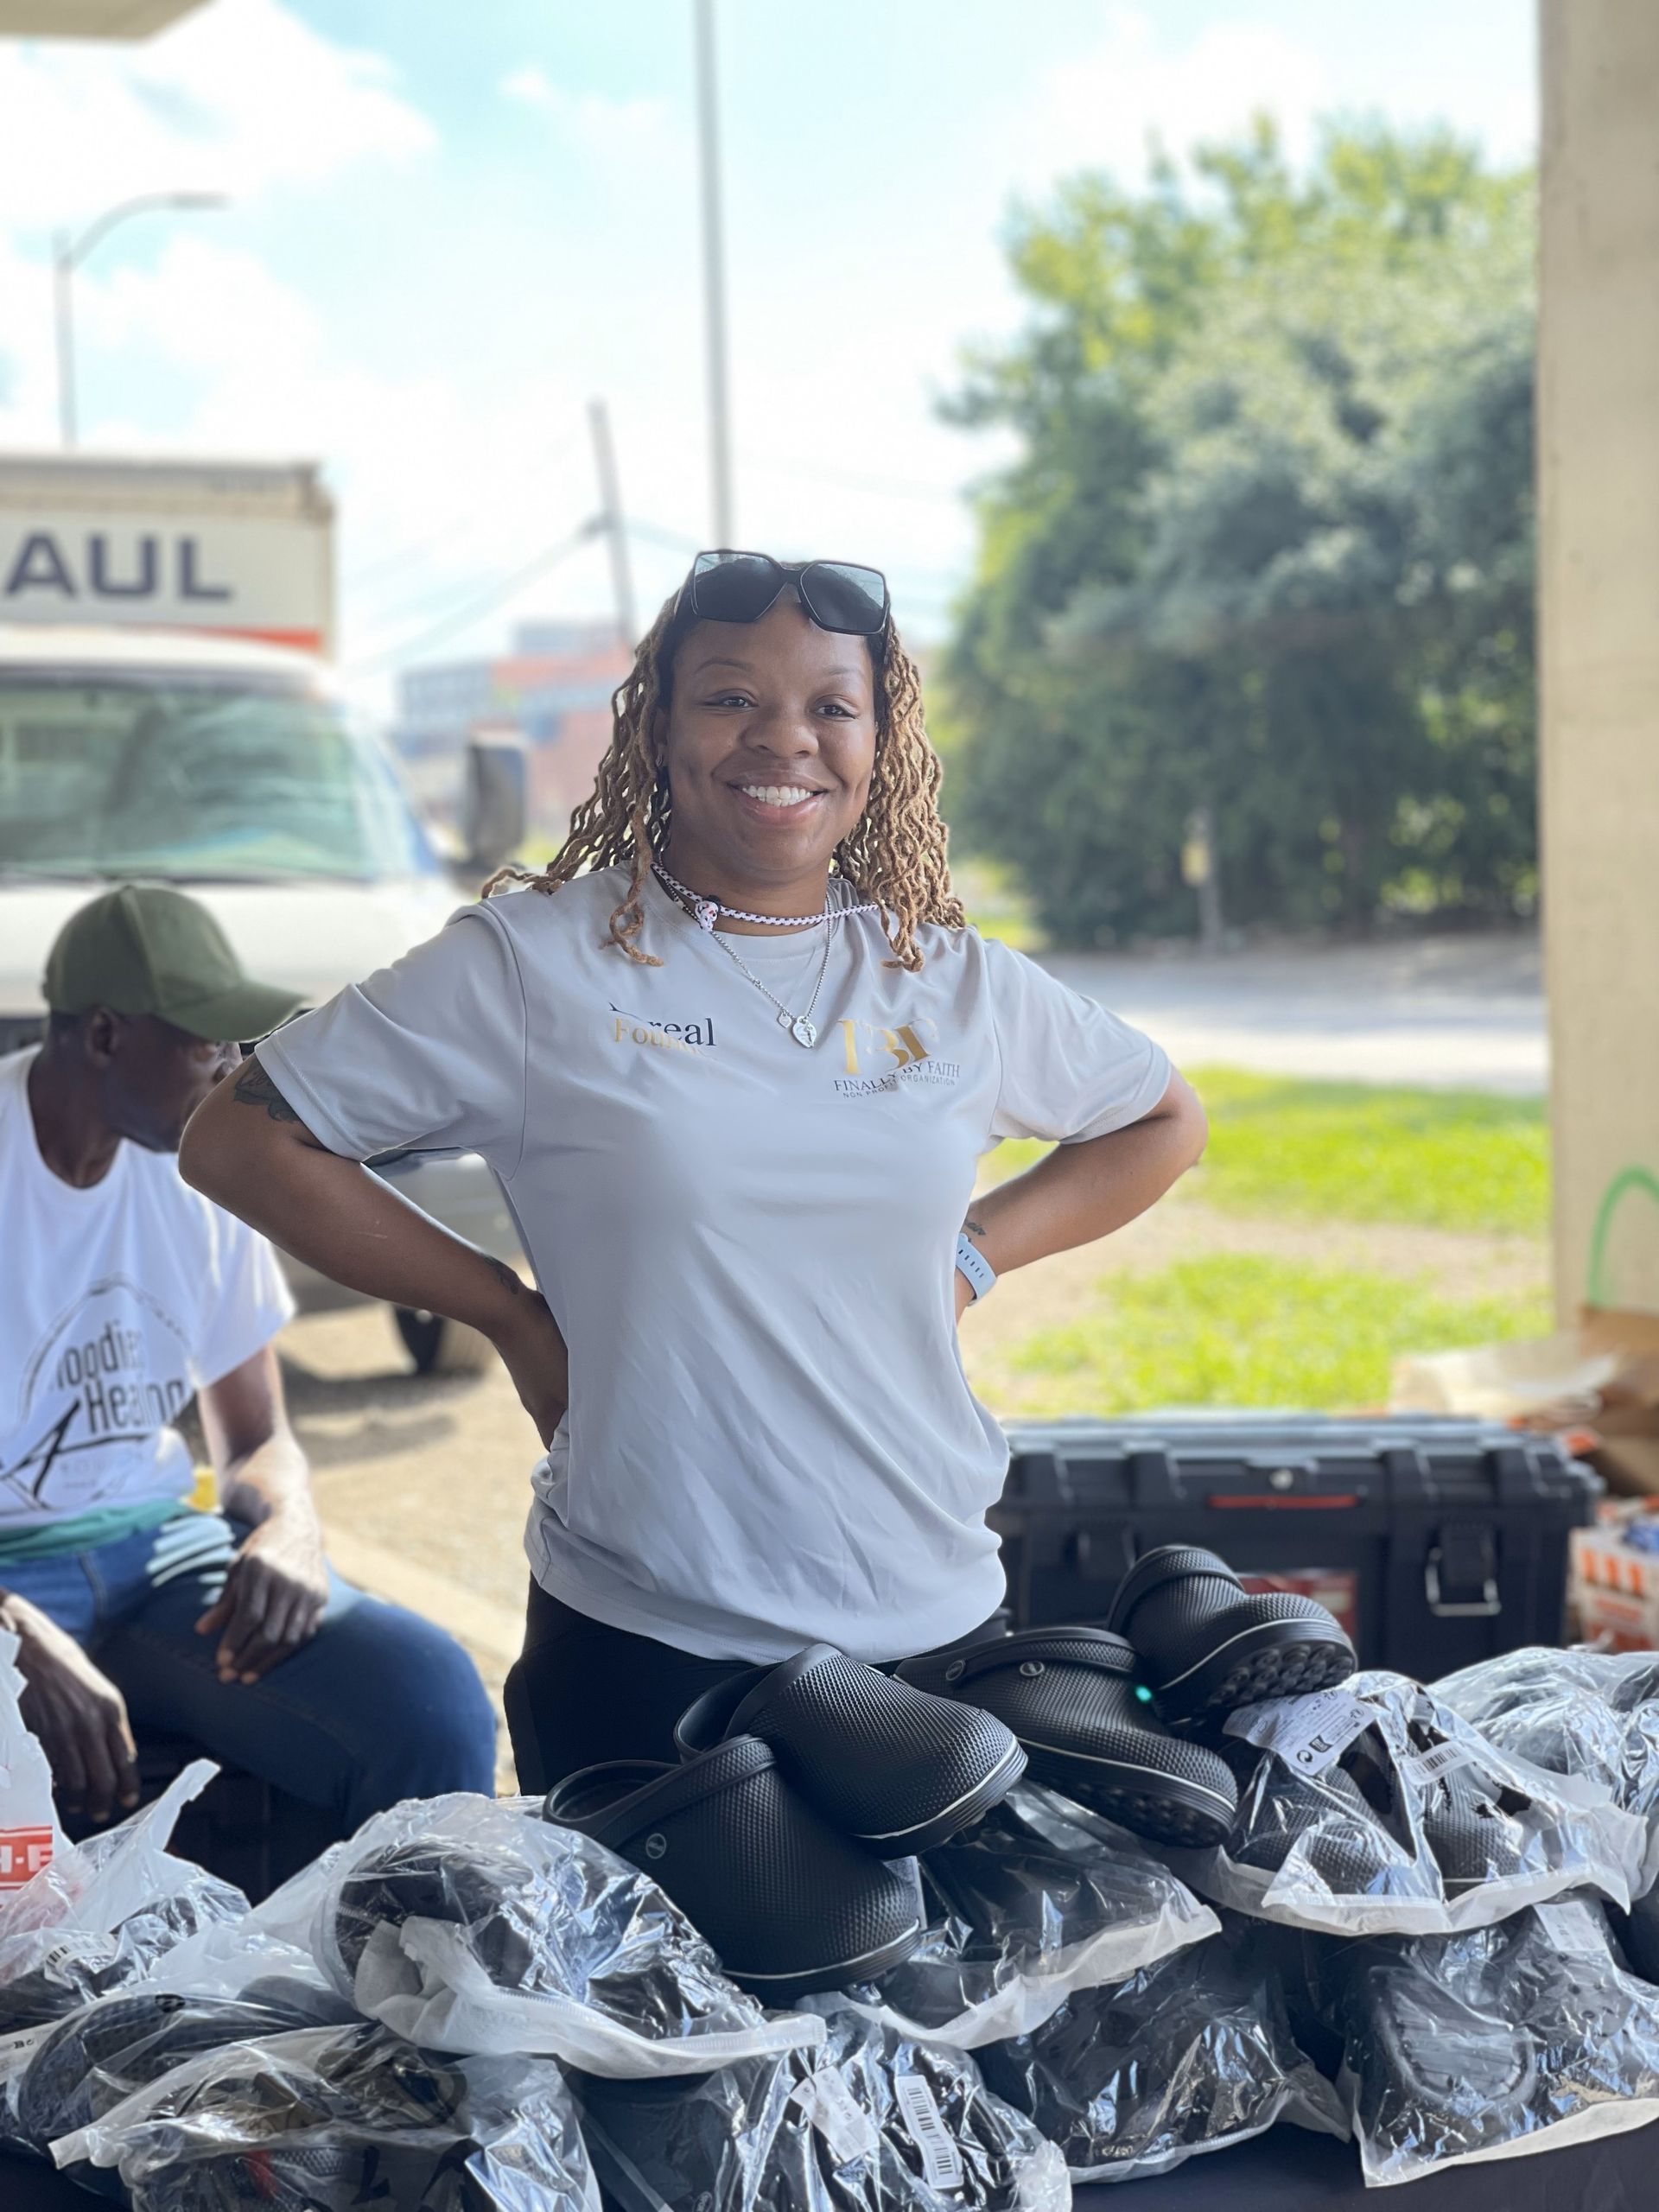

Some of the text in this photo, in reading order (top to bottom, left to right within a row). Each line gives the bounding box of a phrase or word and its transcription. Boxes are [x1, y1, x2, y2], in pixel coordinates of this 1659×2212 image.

[5, 531, 233, 600] AUL
[834, 1060, 961, 1091] FINALLY BY FAITH
[900, 1074, 956, 1086] ORGANIZATION
